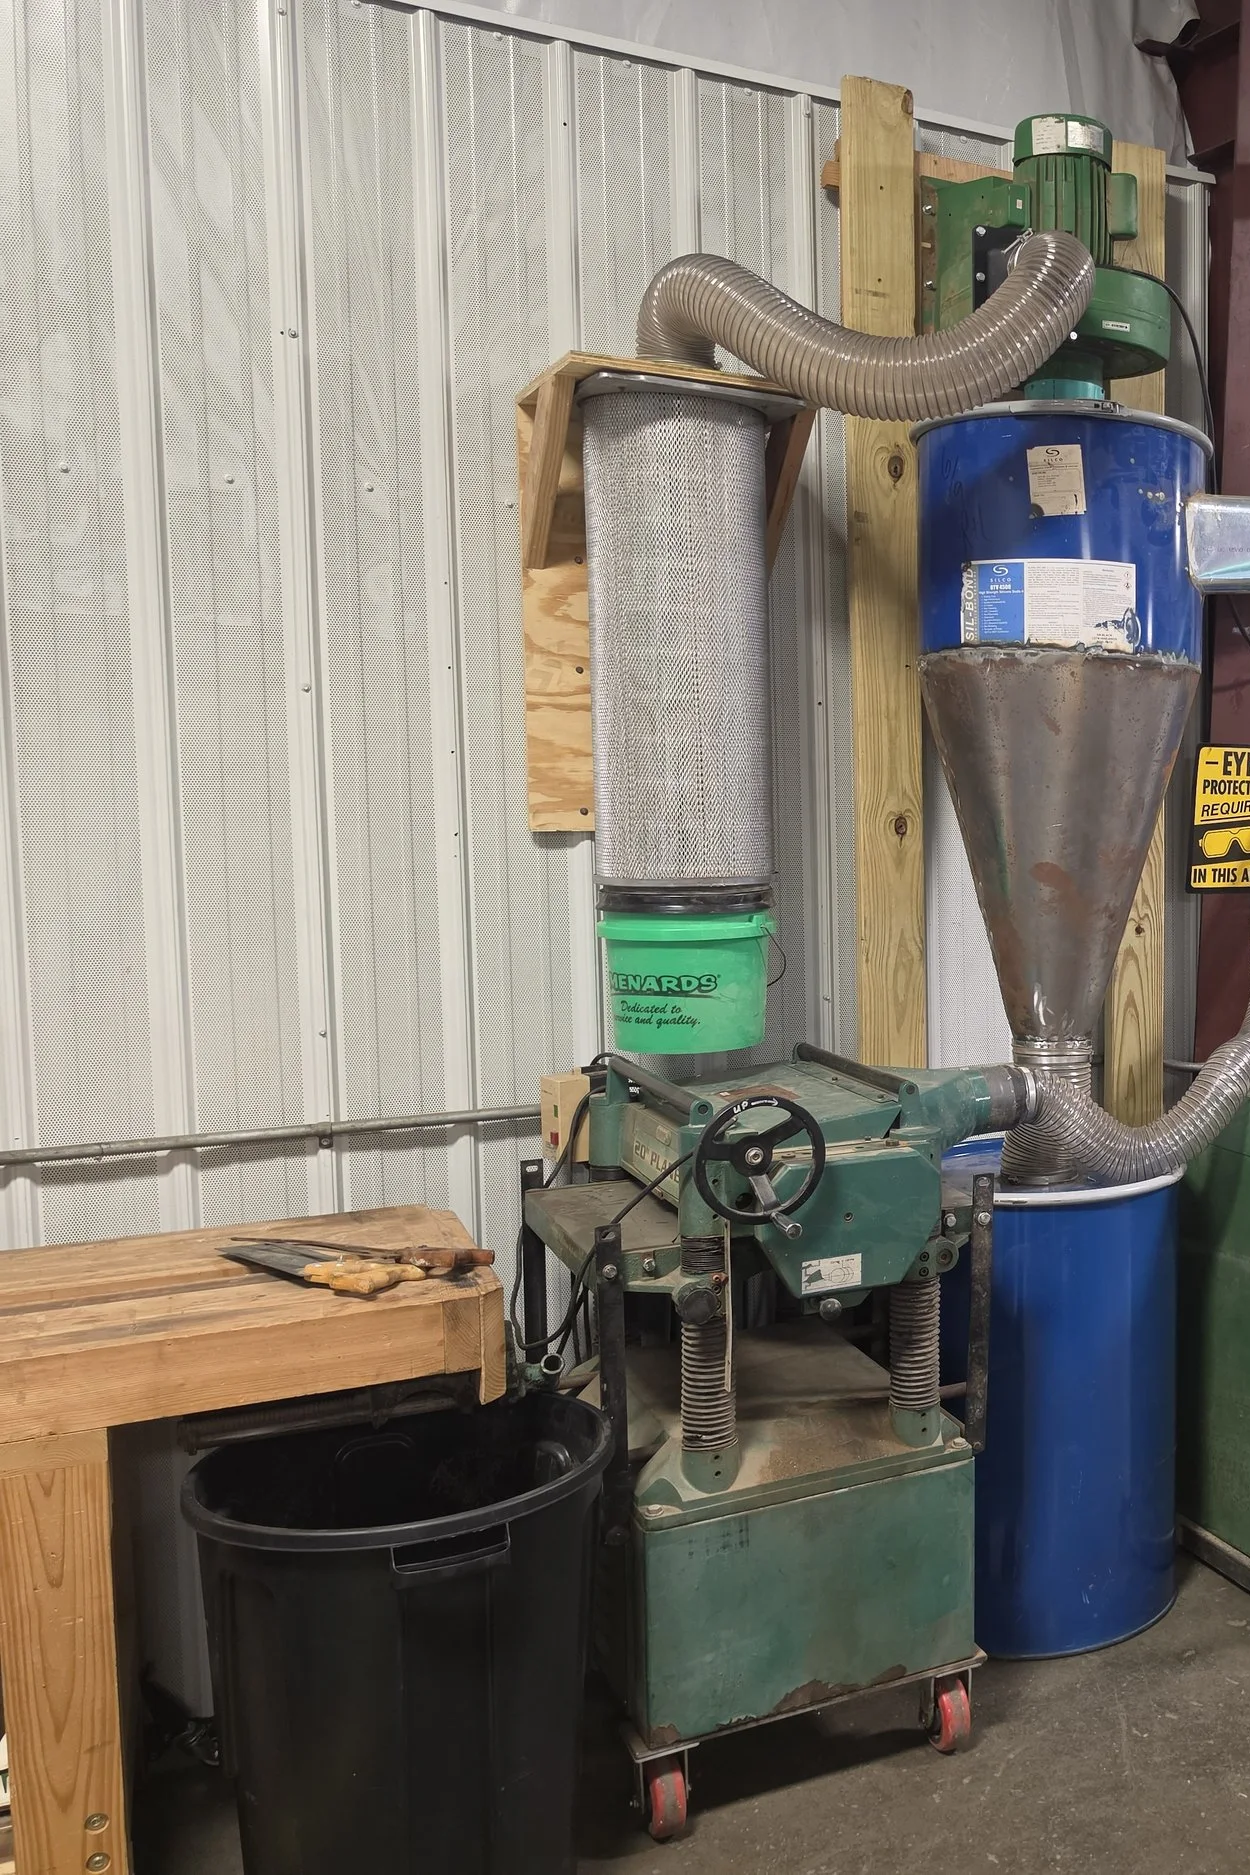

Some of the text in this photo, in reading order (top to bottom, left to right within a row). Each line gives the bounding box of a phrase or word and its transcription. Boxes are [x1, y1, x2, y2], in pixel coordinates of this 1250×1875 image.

[965, 568, 975, 642] SIL-BOND
[1193, 868, 1206, 883] IN
[1212, 867, 1237, 883] THIS
[609, 972, 717, 994] MENARDS
[620, 1000, 682, 1014] Dedicated to
[635, 1014, 653, 1025] and
[656, 1014, 701, 1029] quality.
[733, 1100, 749, 1114] UP
